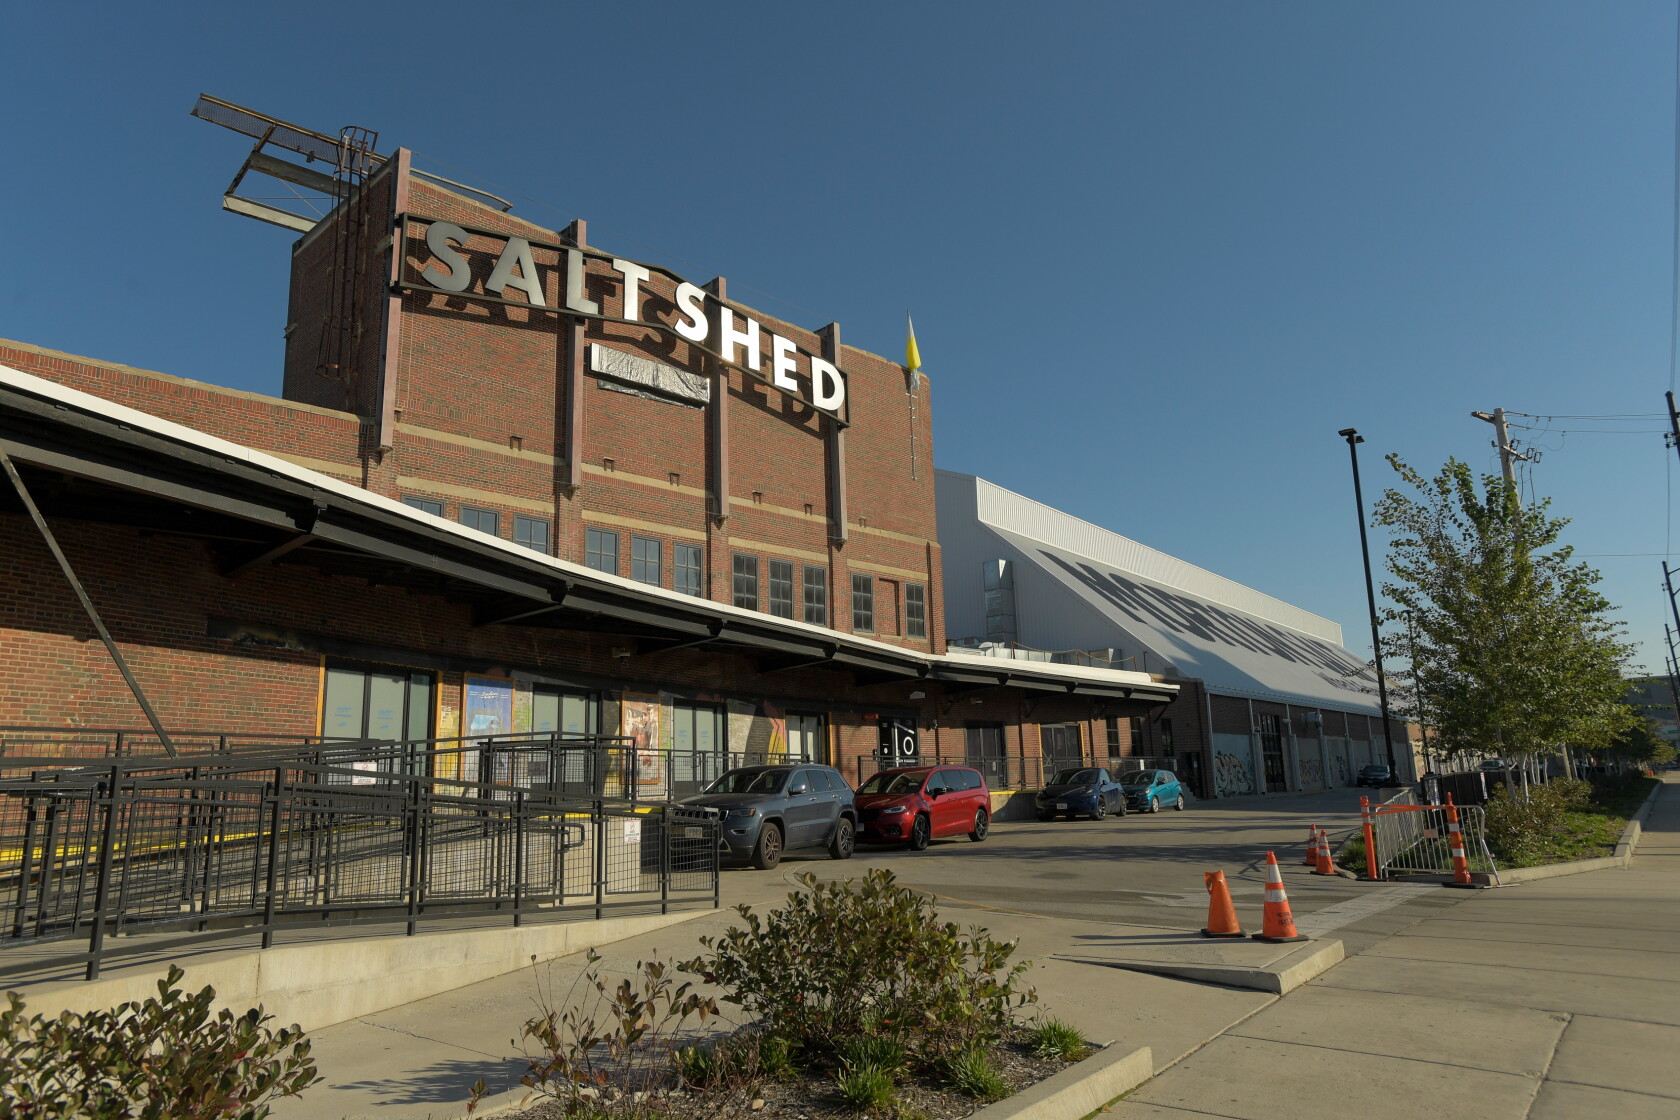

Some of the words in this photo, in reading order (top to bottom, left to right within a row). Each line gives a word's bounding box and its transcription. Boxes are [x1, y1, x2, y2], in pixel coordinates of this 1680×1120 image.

[421, 220, 650, 321] SALT
[674, 281, 846, 411] SHED
[1036, 549, 1324, 669] MORTON
